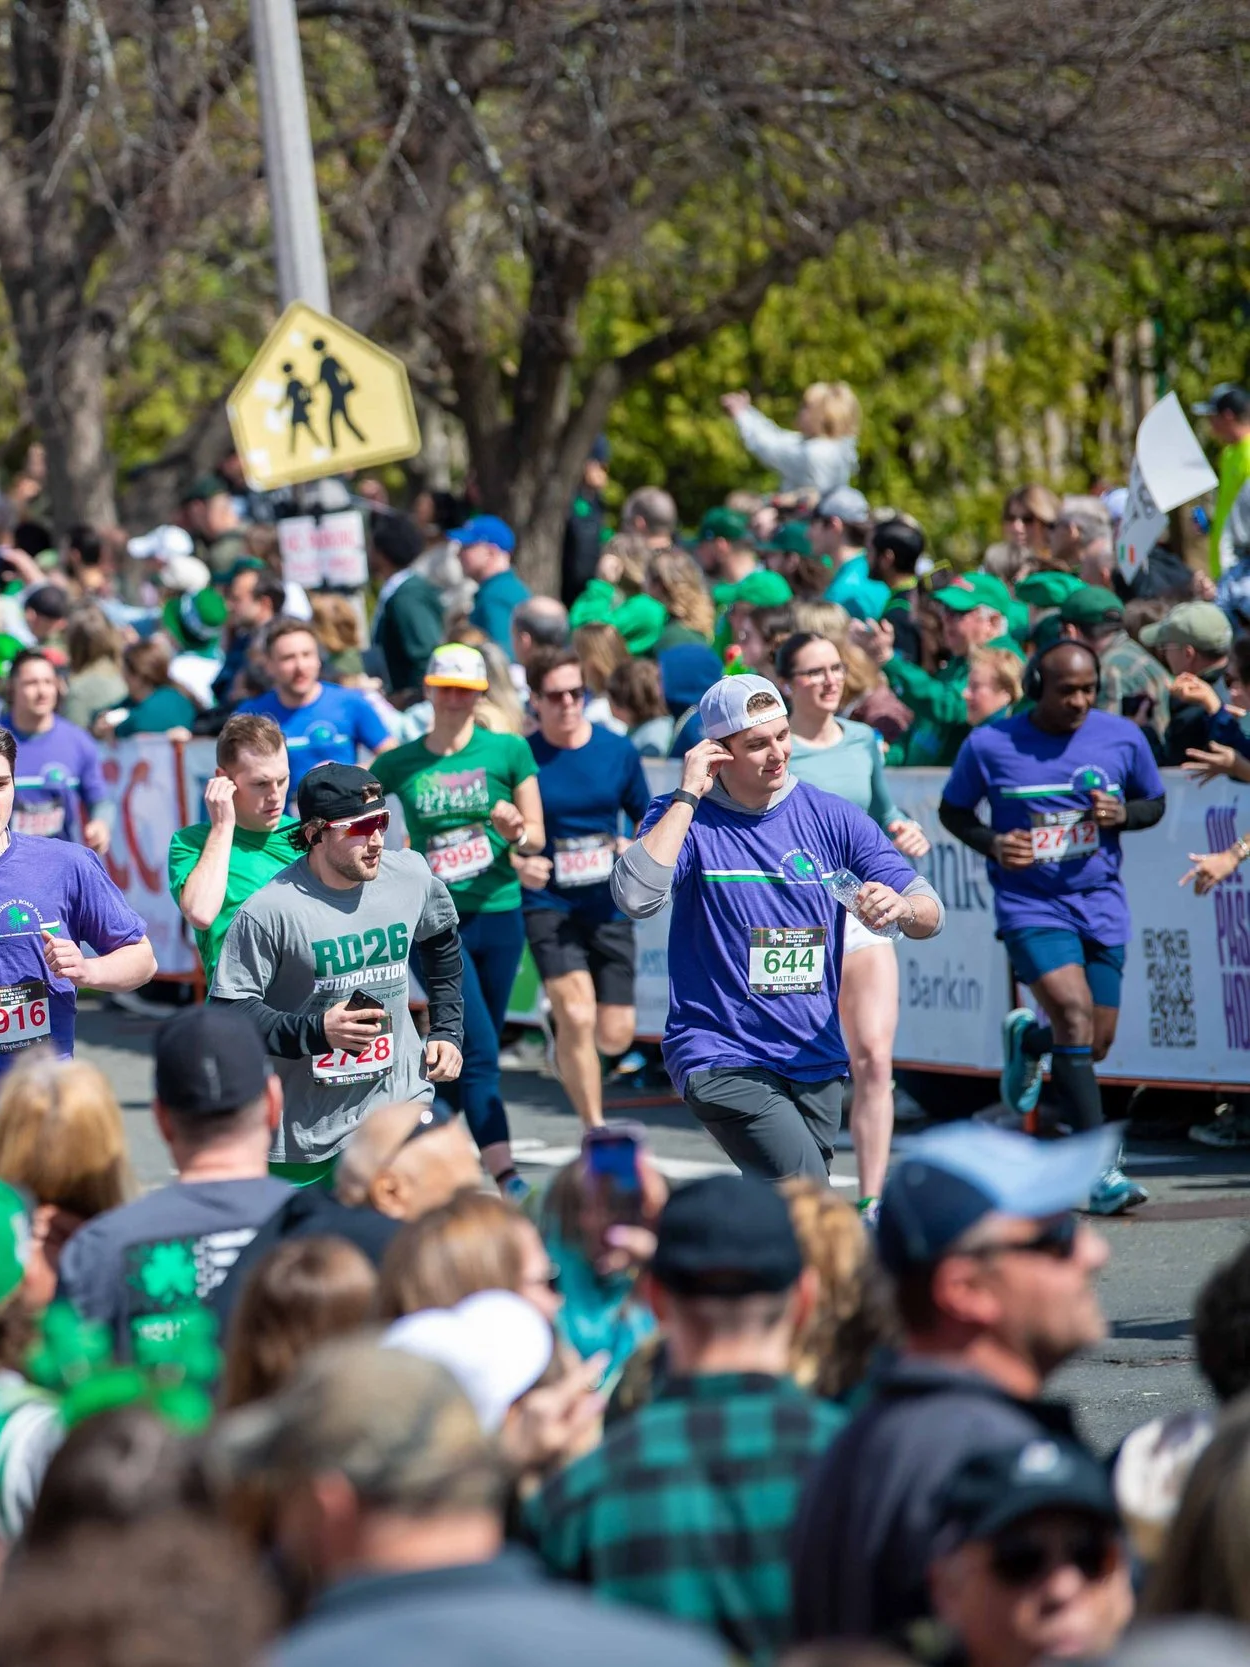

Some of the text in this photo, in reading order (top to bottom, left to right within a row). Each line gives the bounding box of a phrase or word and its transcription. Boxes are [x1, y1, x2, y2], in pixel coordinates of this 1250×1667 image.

[1036, 821, 1095, 848] 2712
[430, 840, 487, 873] 2995
[18, 899, 33, 908] ROAD
[33, 908, 44, 922] RACE
[1215, 889, 1250, 967] PAS
[311, 922, 408, 977] RD26
[764, 948, 815, 975] 644
[313, 959, 407, 994] FOUNDATION
[773, 974, 808, 982] MATTHEW
[1, 1039, 31, 1052] PeoplesBank
[344, 1073, 374, 1083] PeoplesBank
